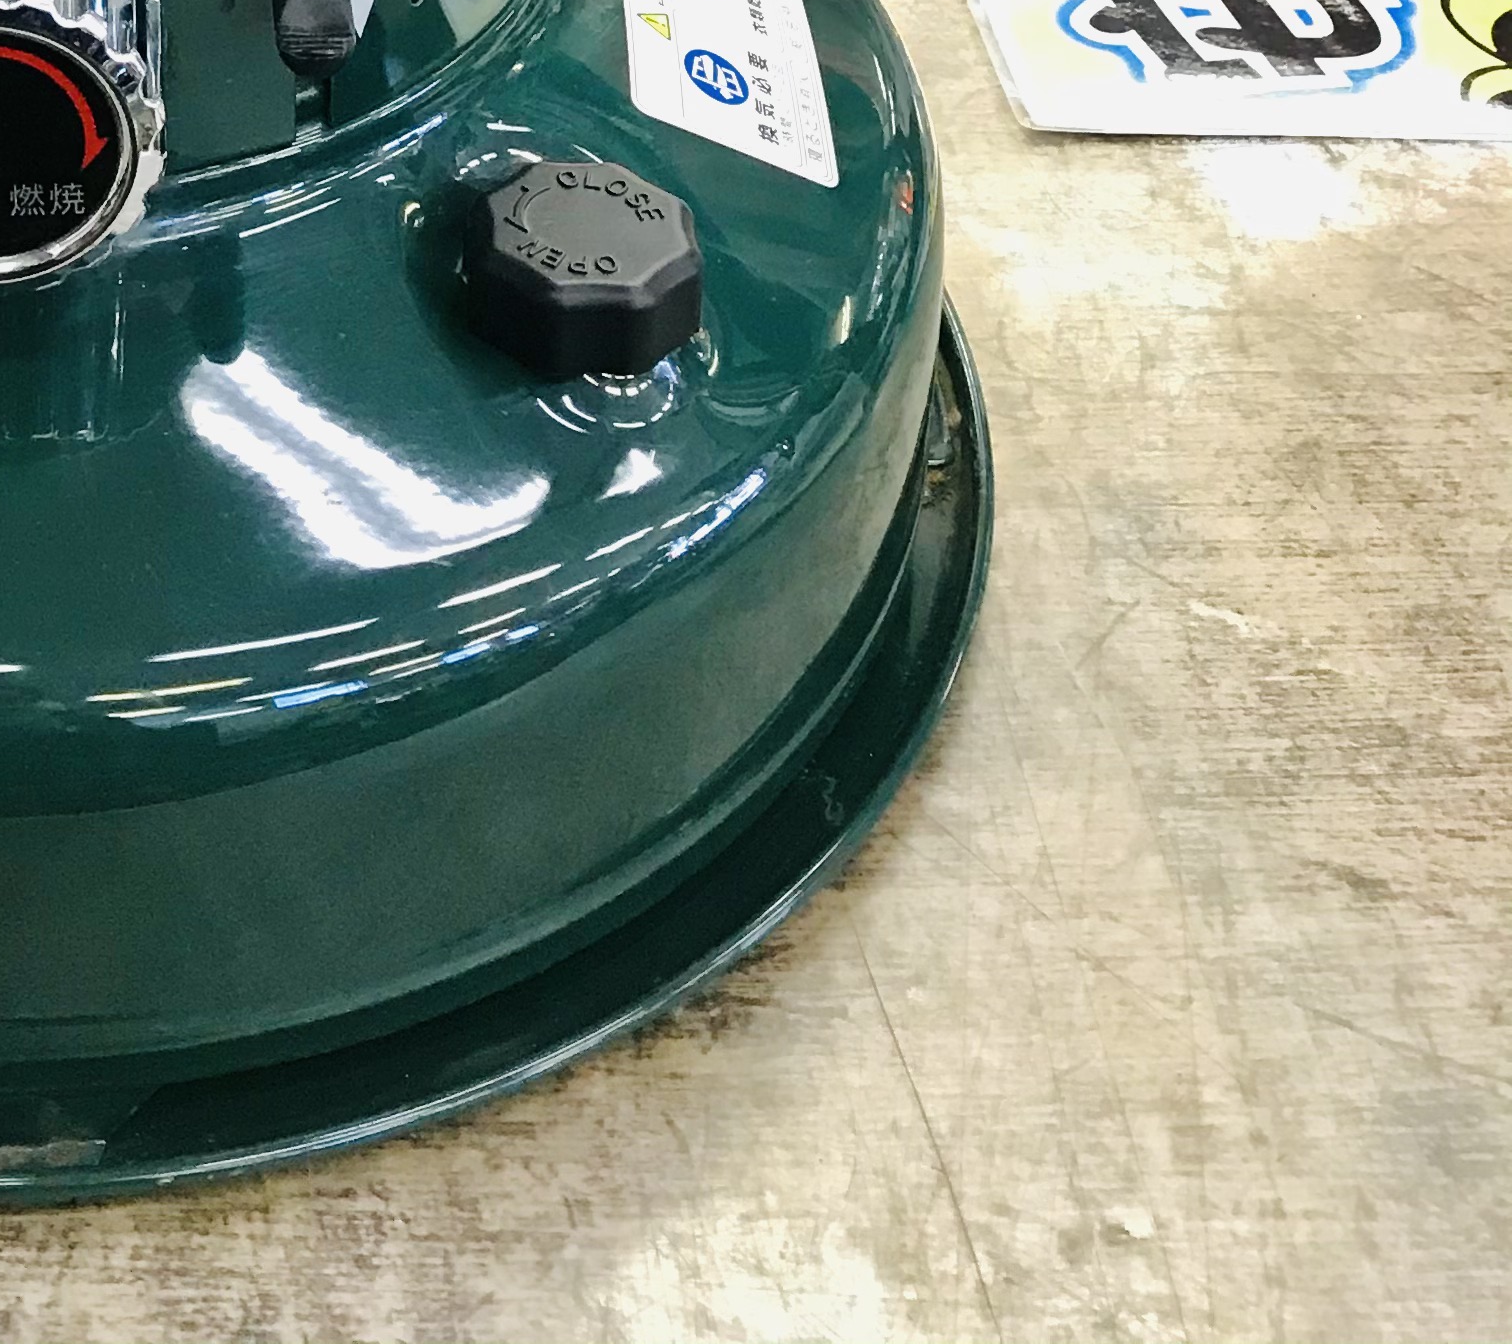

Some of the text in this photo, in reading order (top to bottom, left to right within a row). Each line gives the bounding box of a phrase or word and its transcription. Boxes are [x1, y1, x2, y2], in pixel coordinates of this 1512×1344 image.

[747, 49, 781, 147] 換気必要
[7, 181, 87, 218] 燃焼
[555, 170, 665, 223] CLOSE
[515, 238, 621, 275] OPEN
